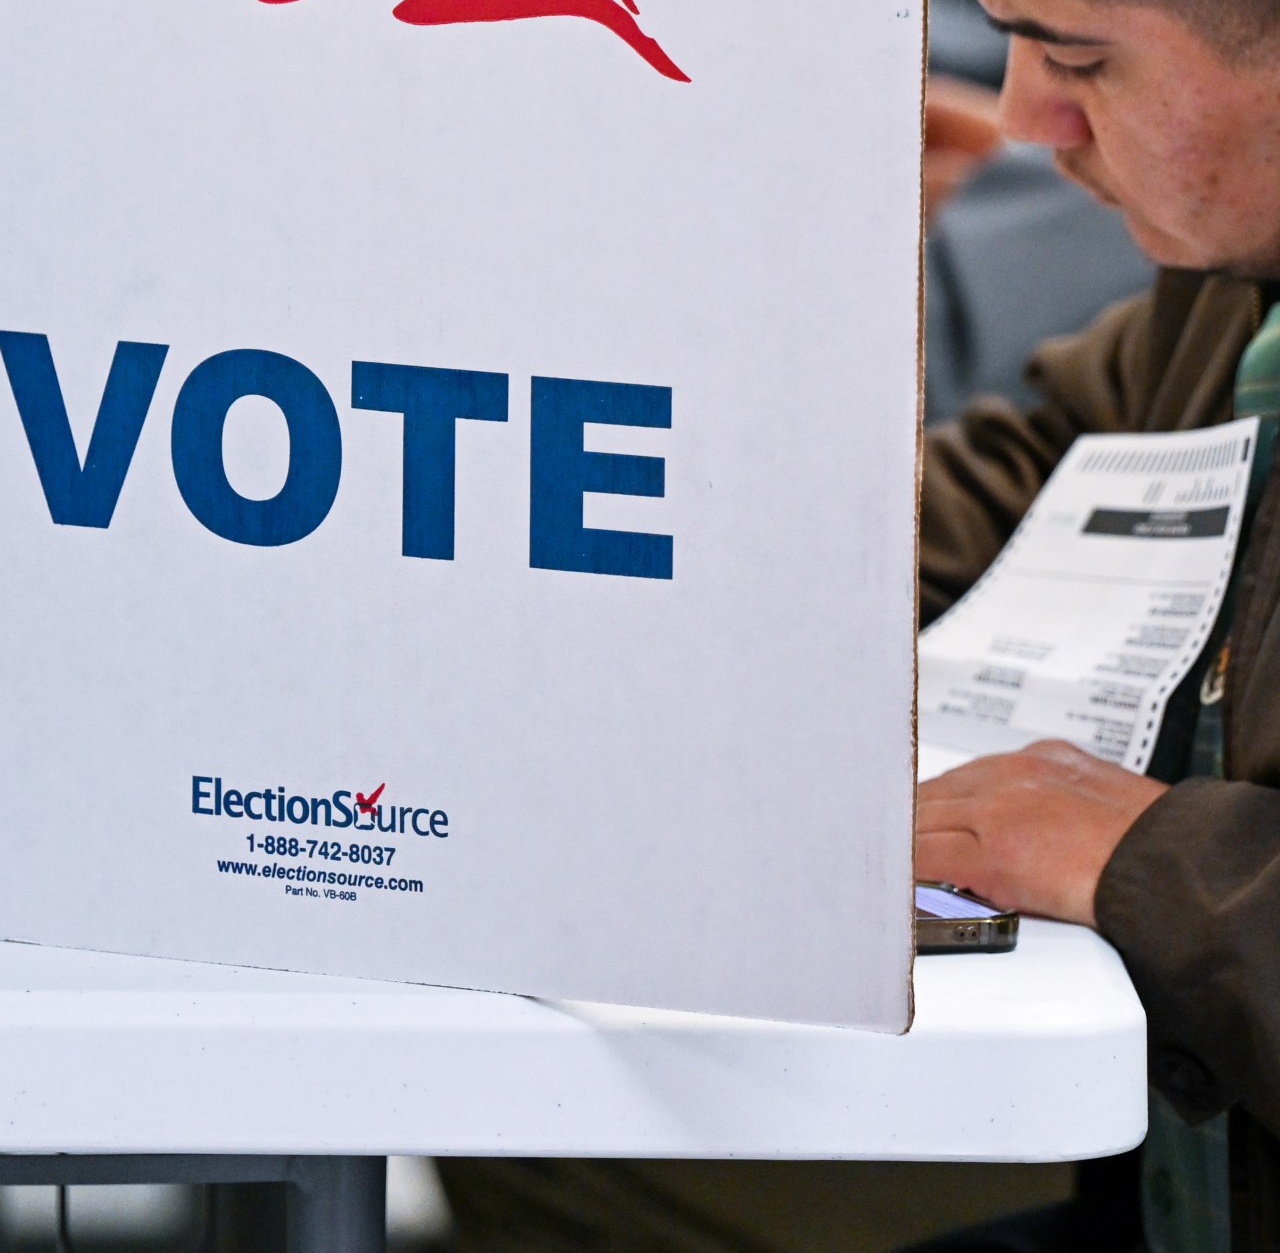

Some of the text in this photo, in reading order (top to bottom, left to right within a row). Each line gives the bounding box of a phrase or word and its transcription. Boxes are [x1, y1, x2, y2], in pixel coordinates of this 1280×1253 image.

[191, 775, 449, 838] ElectionSource
[246, 833, 396, 866] 1-888-742-8037
[217, 859, 423, 893] www.electionsource.com
[285, 884, 304, 896] Part
[305, 887, 321, 898] No.
